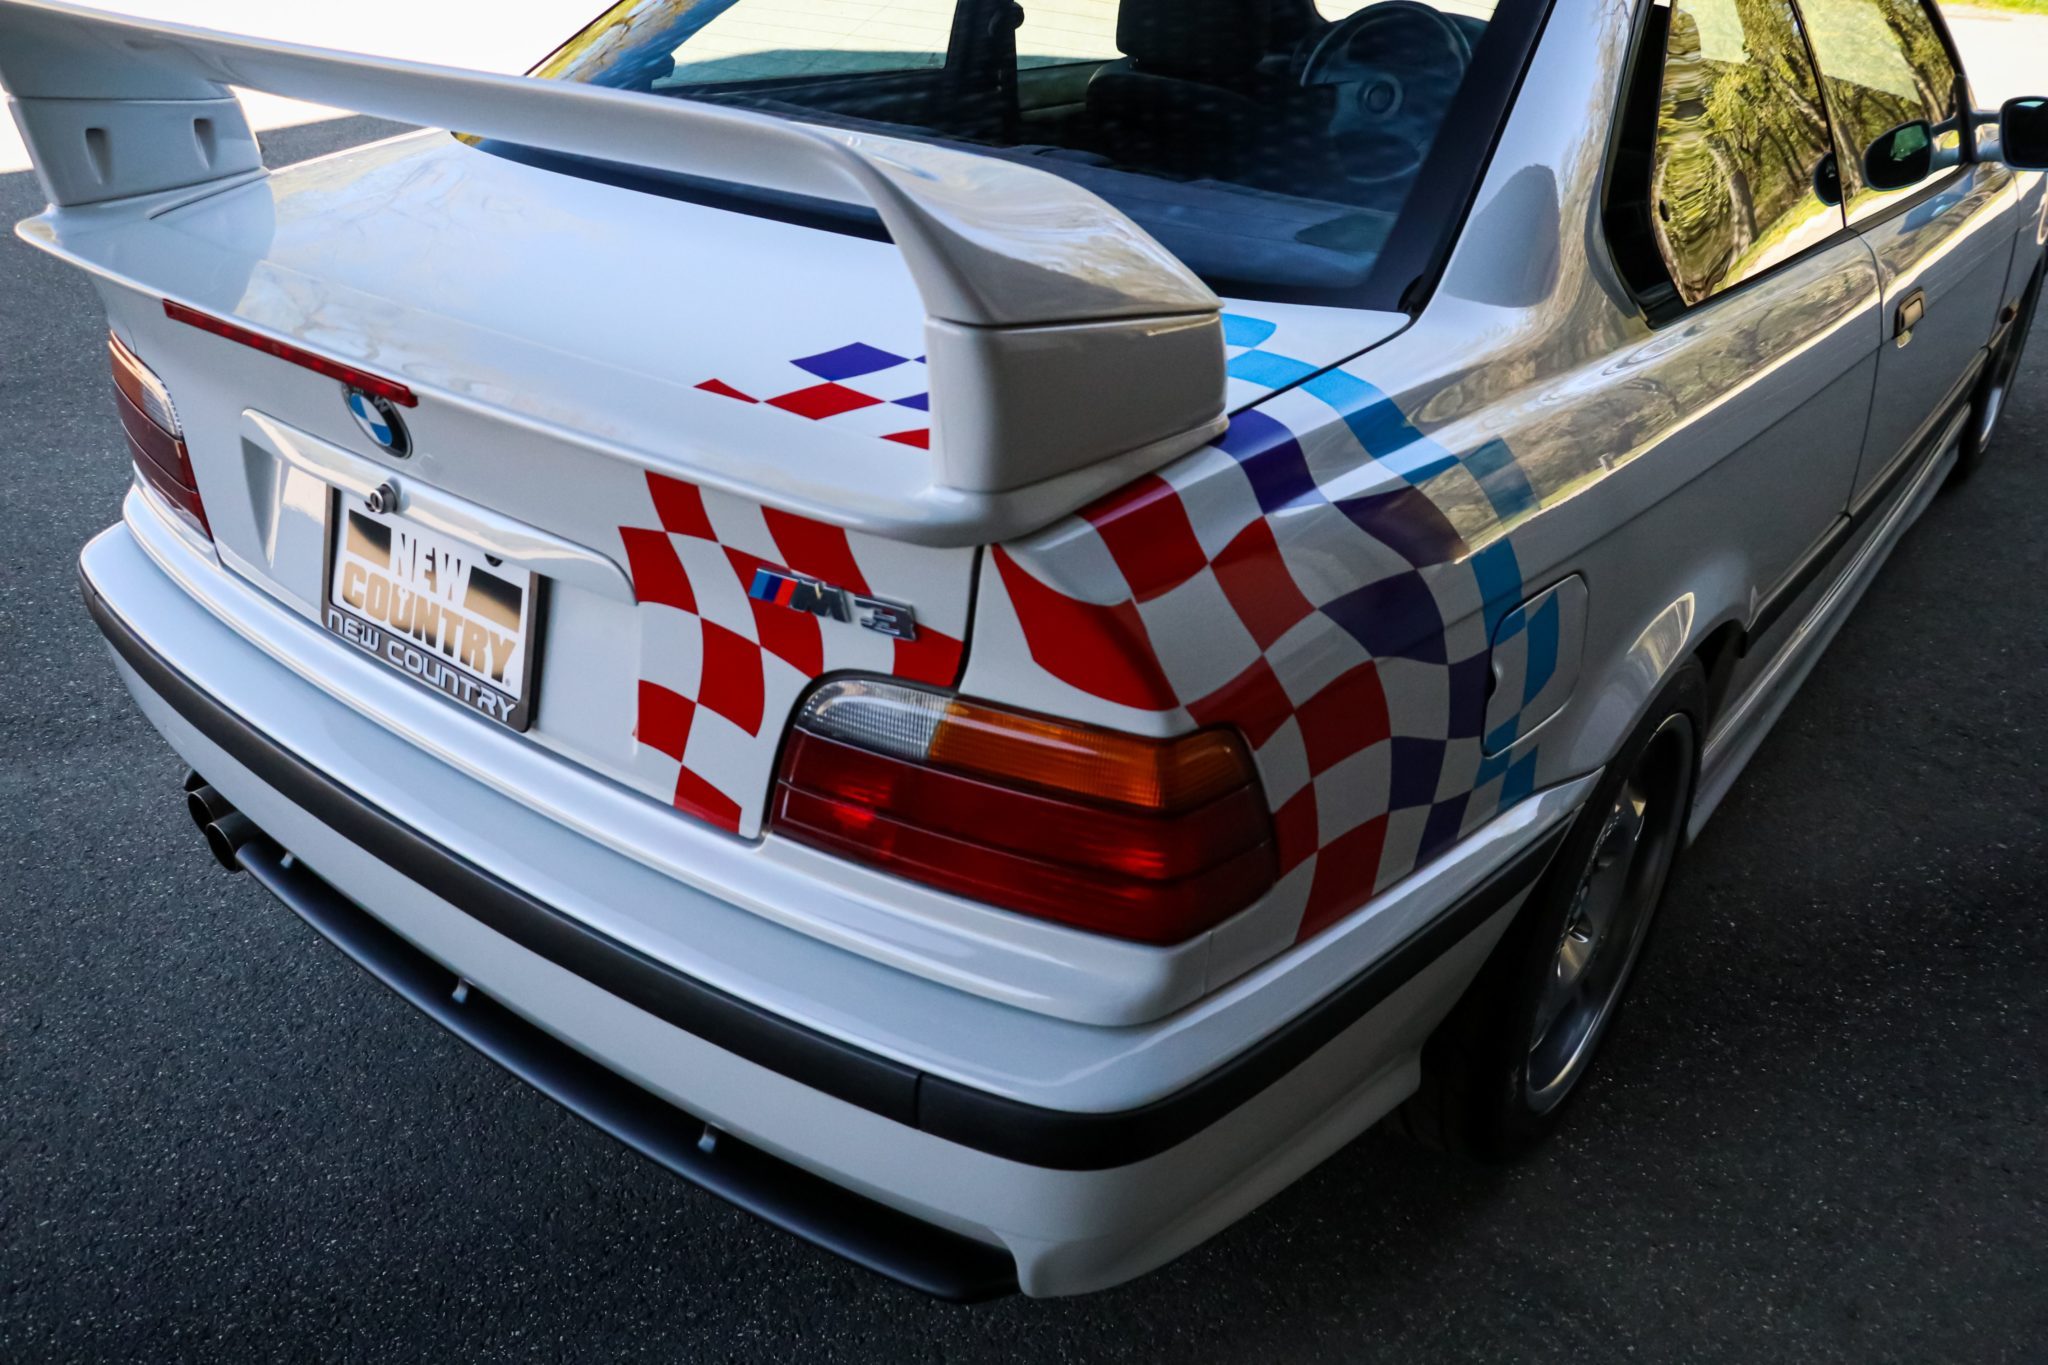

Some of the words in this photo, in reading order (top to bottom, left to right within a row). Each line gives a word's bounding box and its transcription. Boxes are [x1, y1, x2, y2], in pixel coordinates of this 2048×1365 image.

[390, 529, 473, 605] NEW
[788, 579, 917, 642] M3
[328, 609, 380, 651] NEW
[387, 639, 516, 722] COUNTRY
[342, 560, 516, 684] COUNTRY
